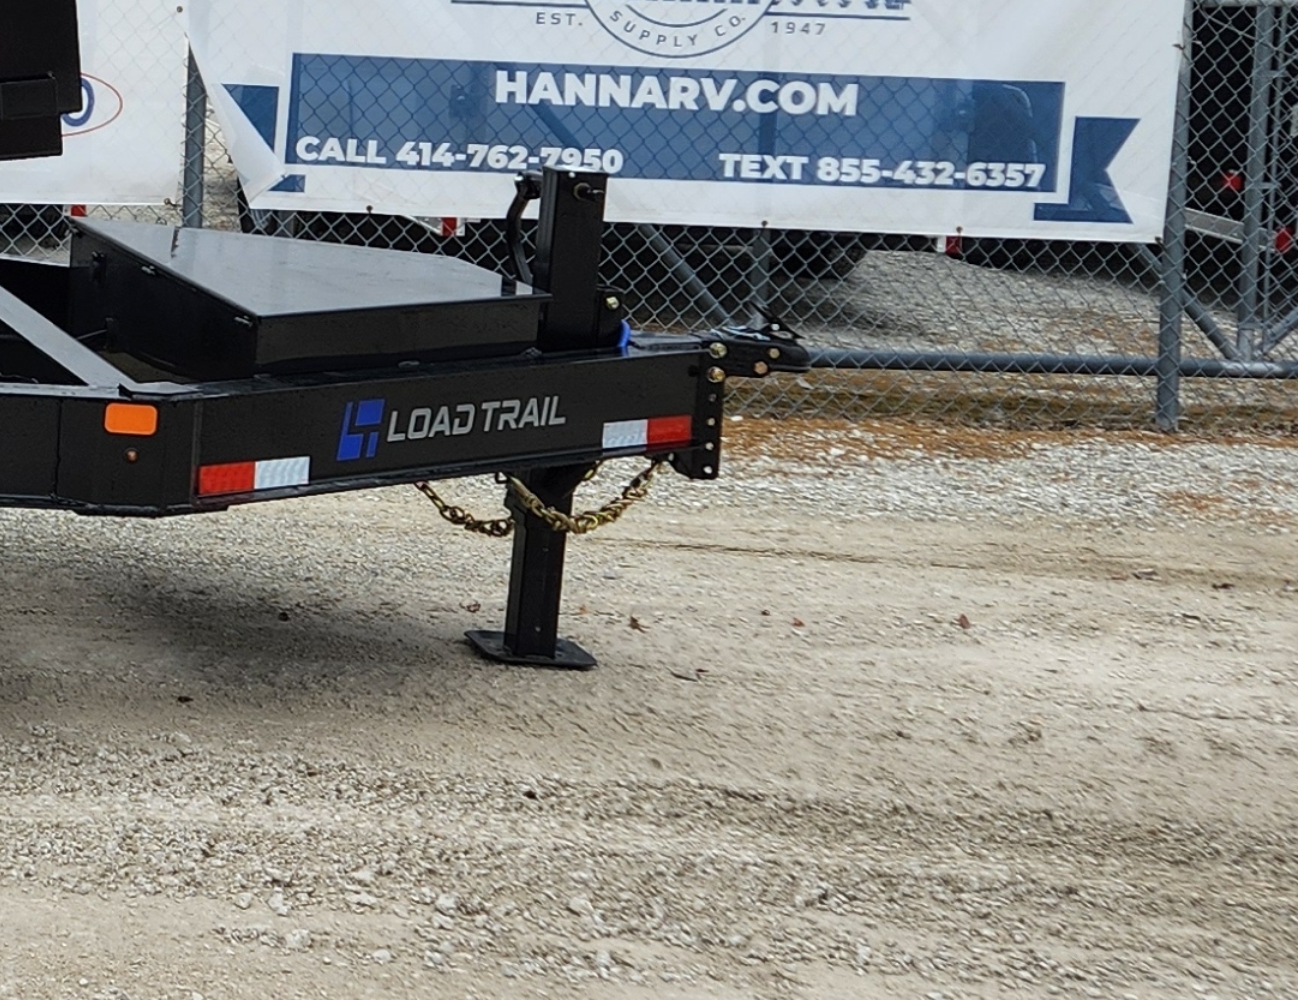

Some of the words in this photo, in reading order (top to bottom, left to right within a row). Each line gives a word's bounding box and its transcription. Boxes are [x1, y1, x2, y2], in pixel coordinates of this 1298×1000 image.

[536, 12, 583, 27] EST.
[610, 10, 699, 47] SUPPLY
[714, 15, 746, 37] CO.
[769, 21, 826, 36] 1947
[495, 69, 860, 117] HANNARV.COM
[296, 136, 388, 165] CALL
[396, 140, 624, 175] 414-762-7950
[719, 152, 809, 180] TEXT
[816, 156, 1047, 188] 855-432-6357
[387, 403, 476, 443] LOAD
[481, 395, 566, 432] TRAIL
